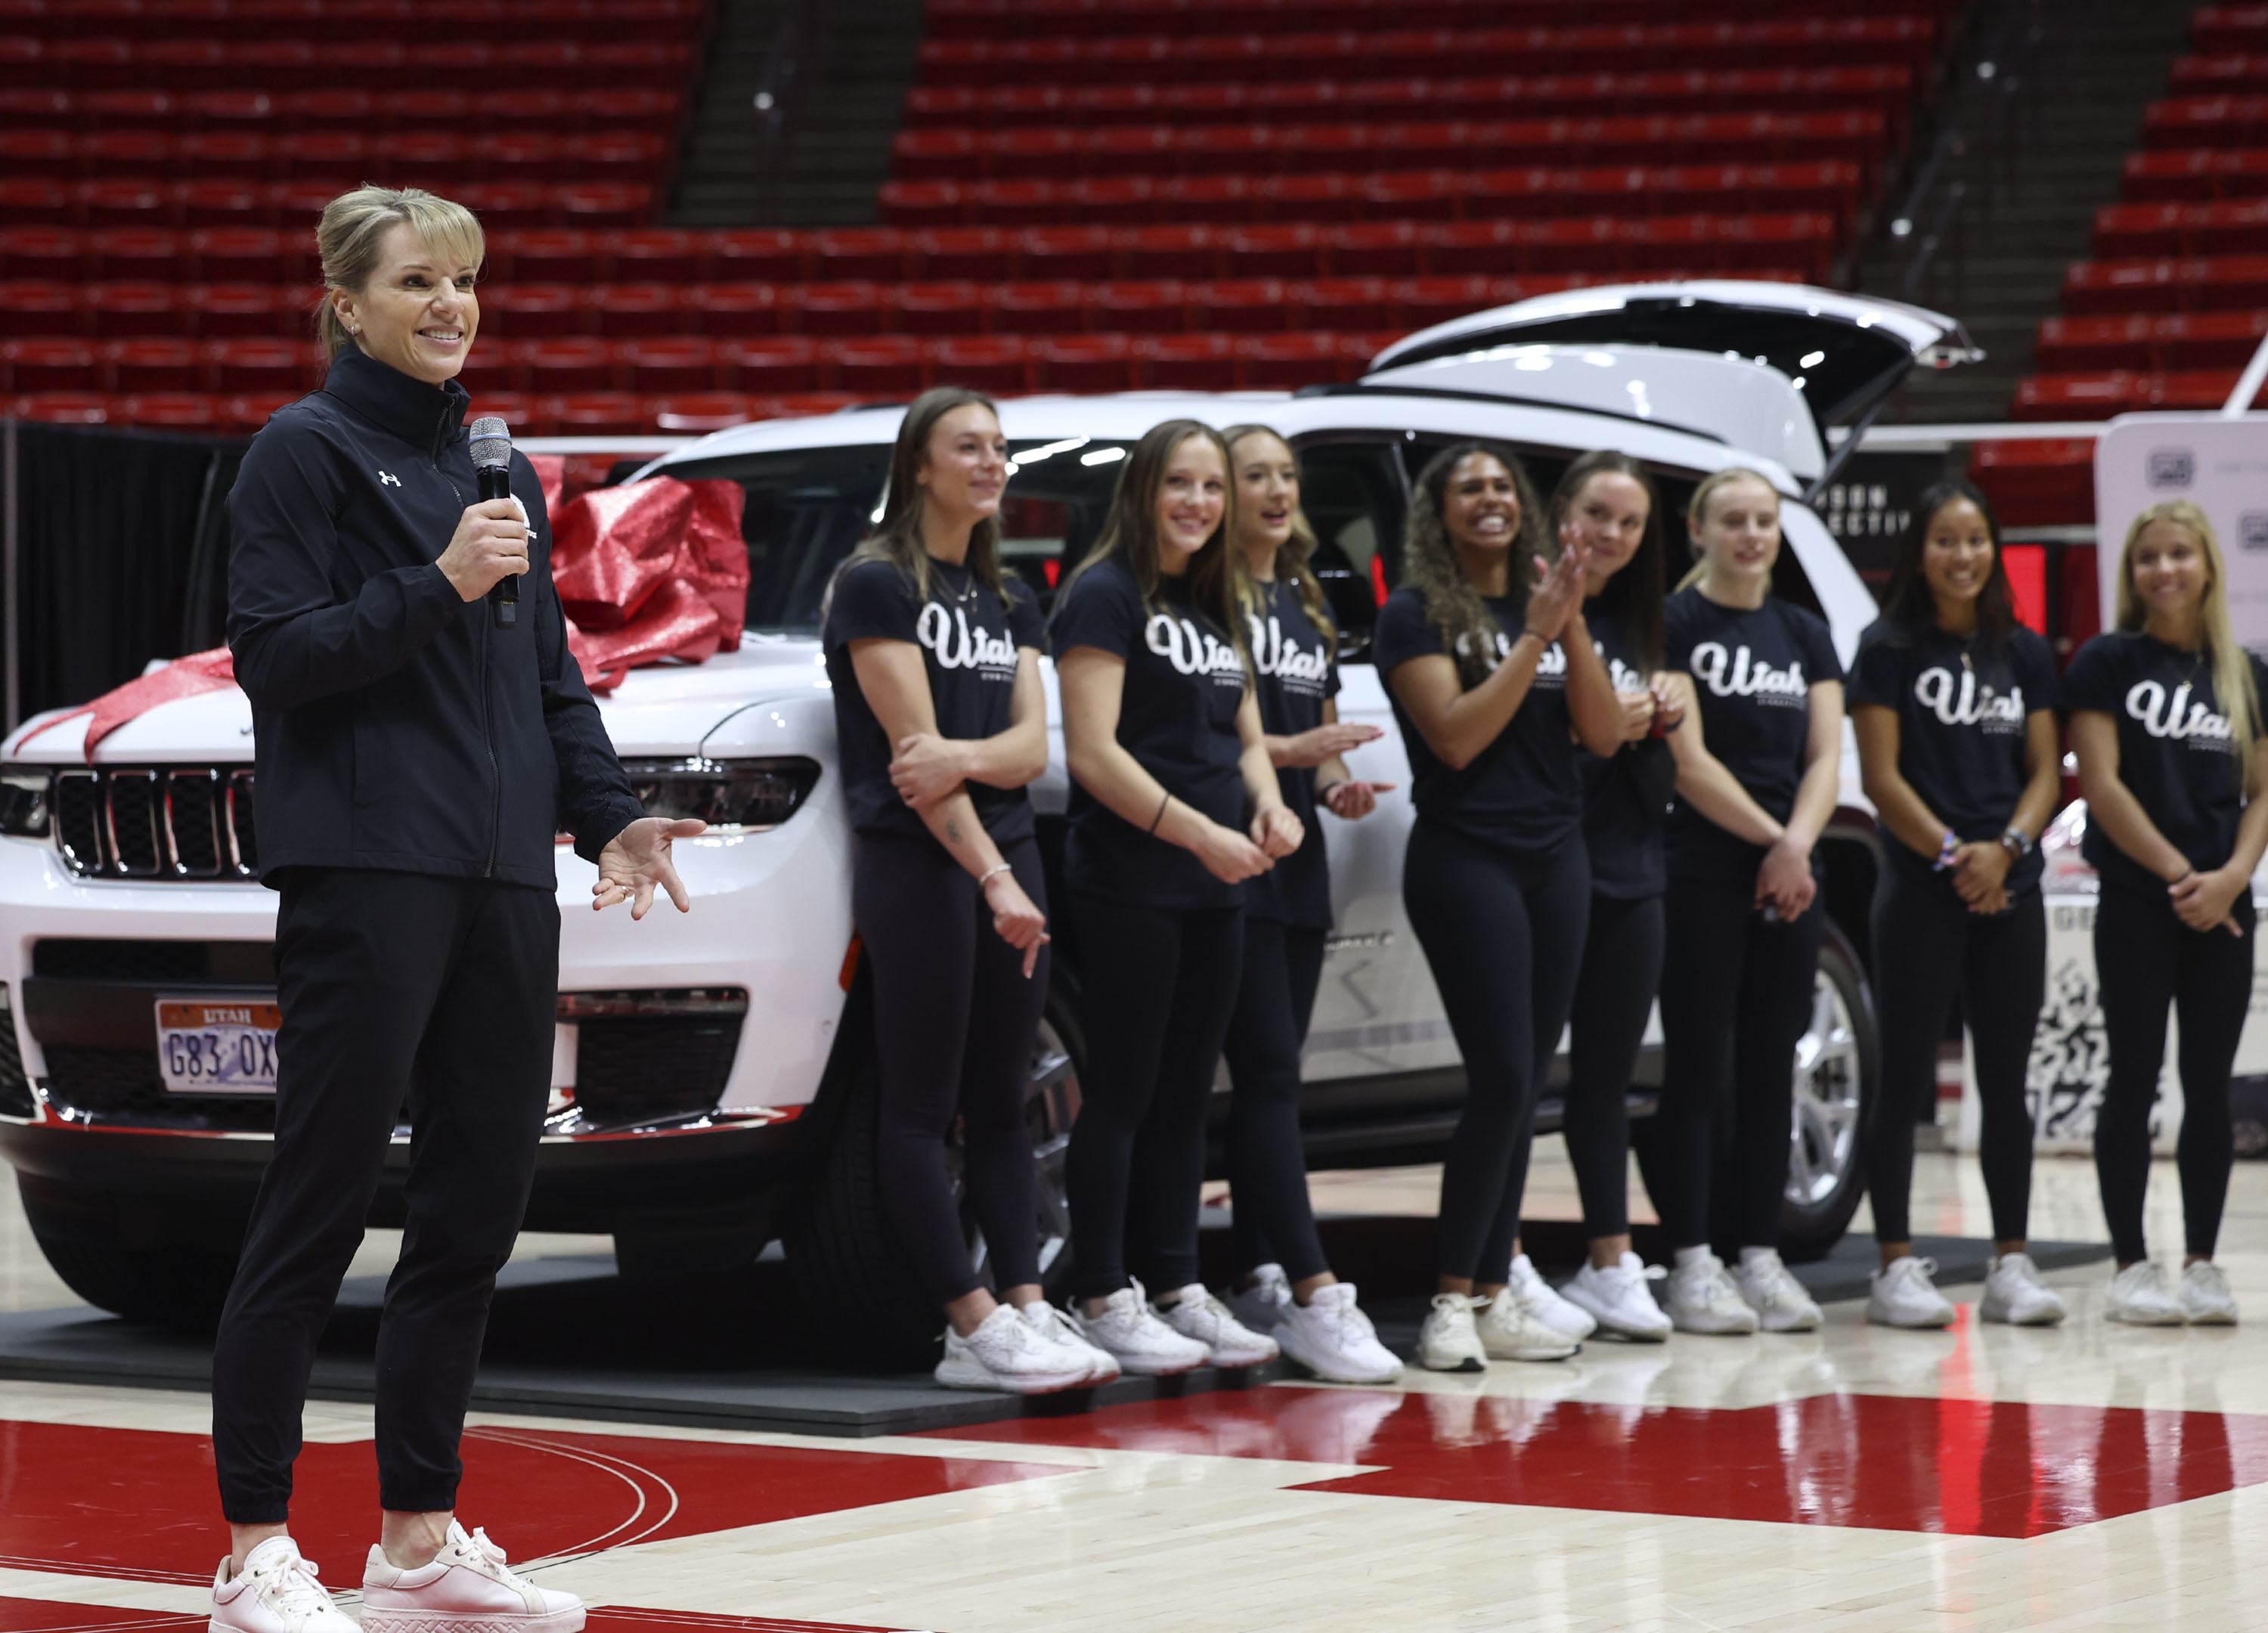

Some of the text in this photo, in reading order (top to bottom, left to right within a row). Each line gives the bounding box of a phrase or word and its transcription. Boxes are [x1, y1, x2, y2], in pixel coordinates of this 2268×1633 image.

[917, 602, 1018, 668] Utah
[1690, 641, 1808, 697] Utah
[2125, 680, 2232, 739] Uta
[203, 1009, 252, 1023] UTAH
[169, 1033, 219, 1075] G83
